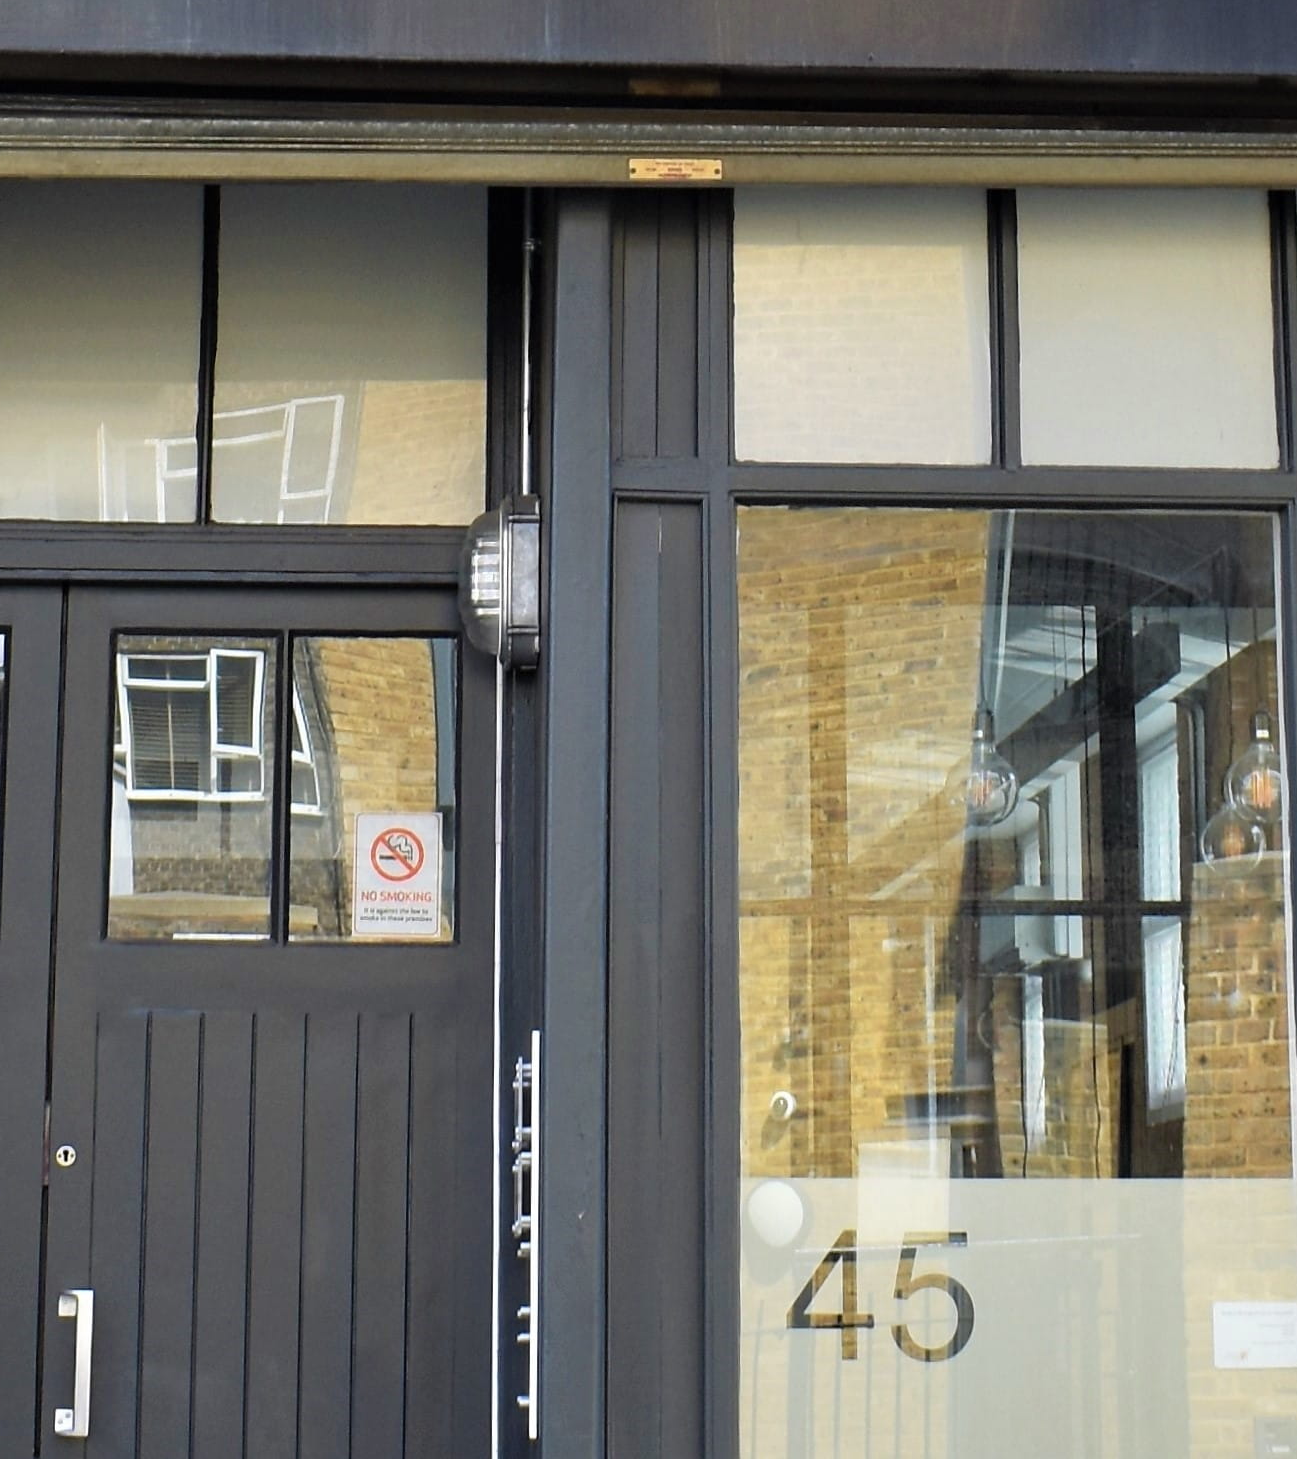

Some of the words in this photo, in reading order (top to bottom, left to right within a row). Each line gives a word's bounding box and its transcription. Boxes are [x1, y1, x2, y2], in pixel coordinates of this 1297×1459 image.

[361, 891, 377, 901] NO
[380, 891, 432, 902] SMOKING
[787, 1228, 975, 1363] 45
